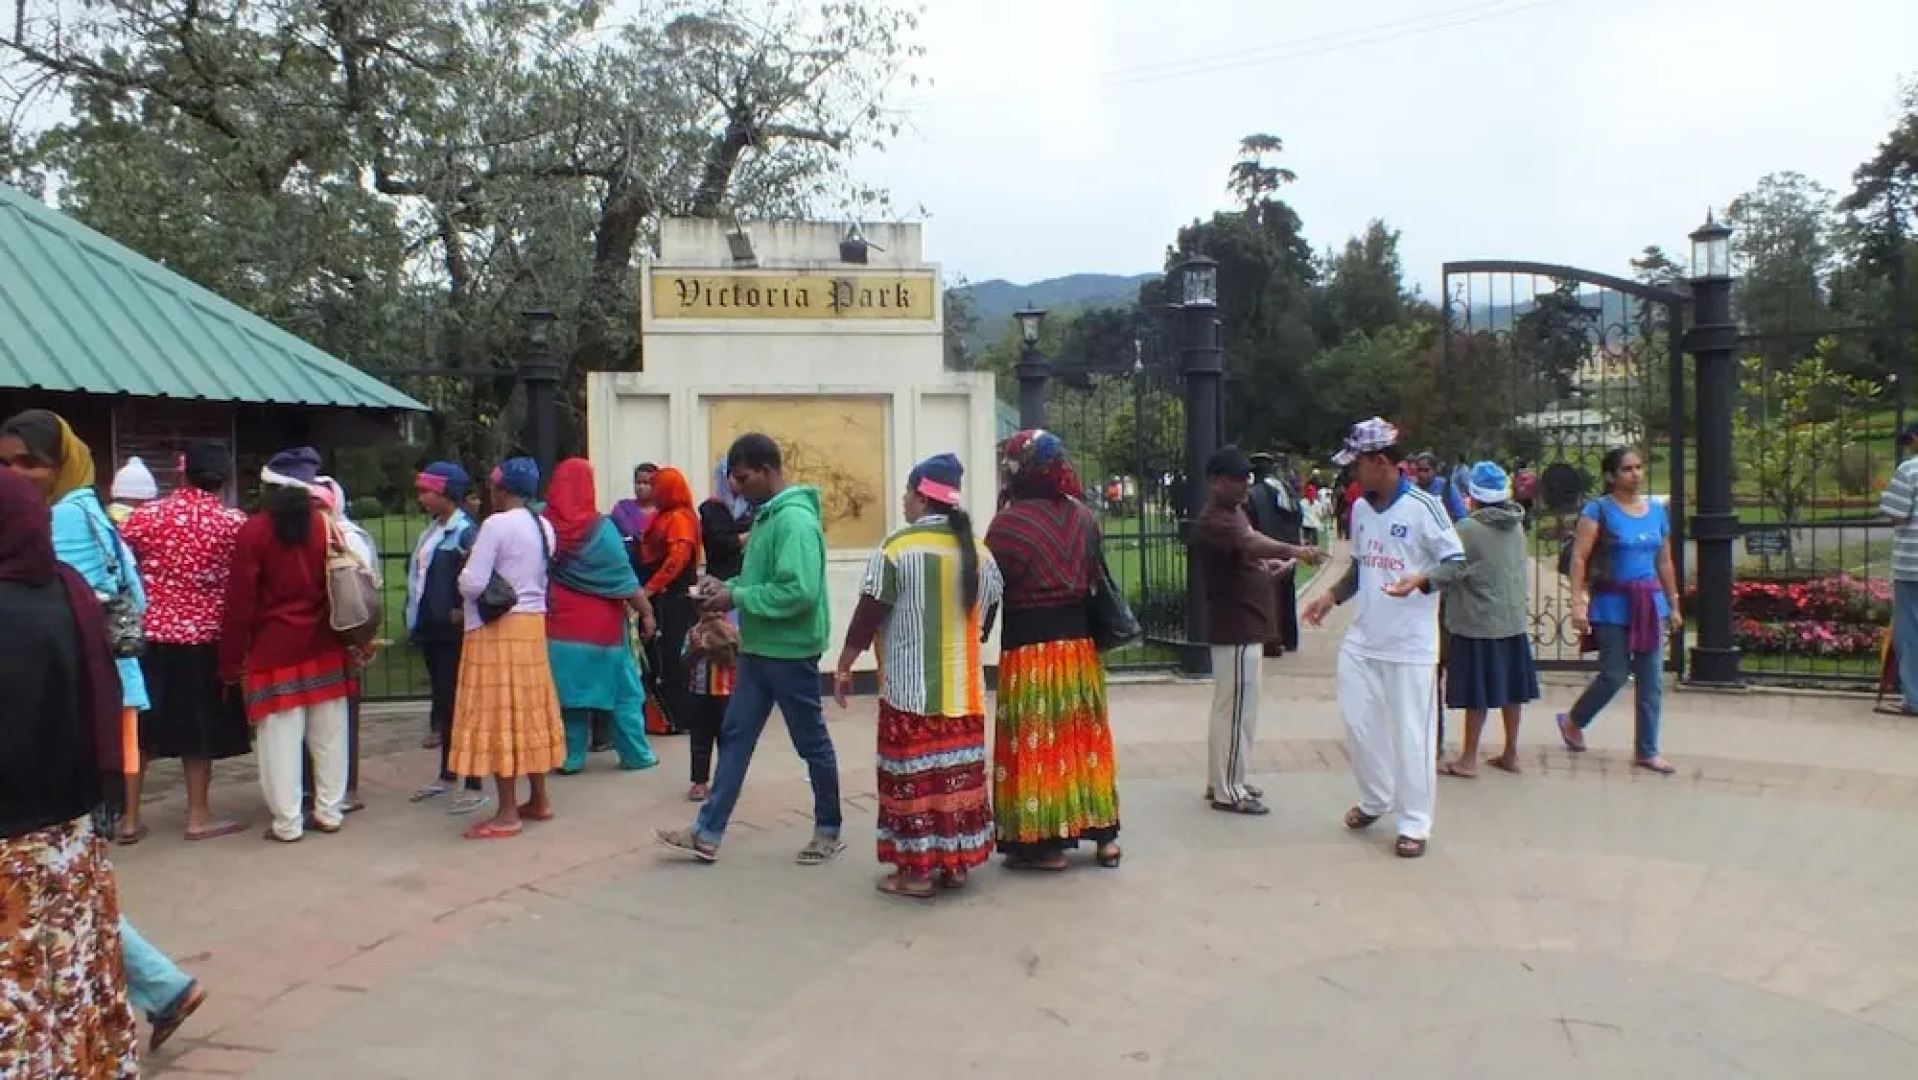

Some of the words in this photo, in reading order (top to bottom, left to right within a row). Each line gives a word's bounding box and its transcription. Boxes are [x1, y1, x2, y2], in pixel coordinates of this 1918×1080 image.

[675, 277, 809, 308] Victoria
[827, 278, 911, 313] Park
[1359, 555, 1405, 570] mirates
